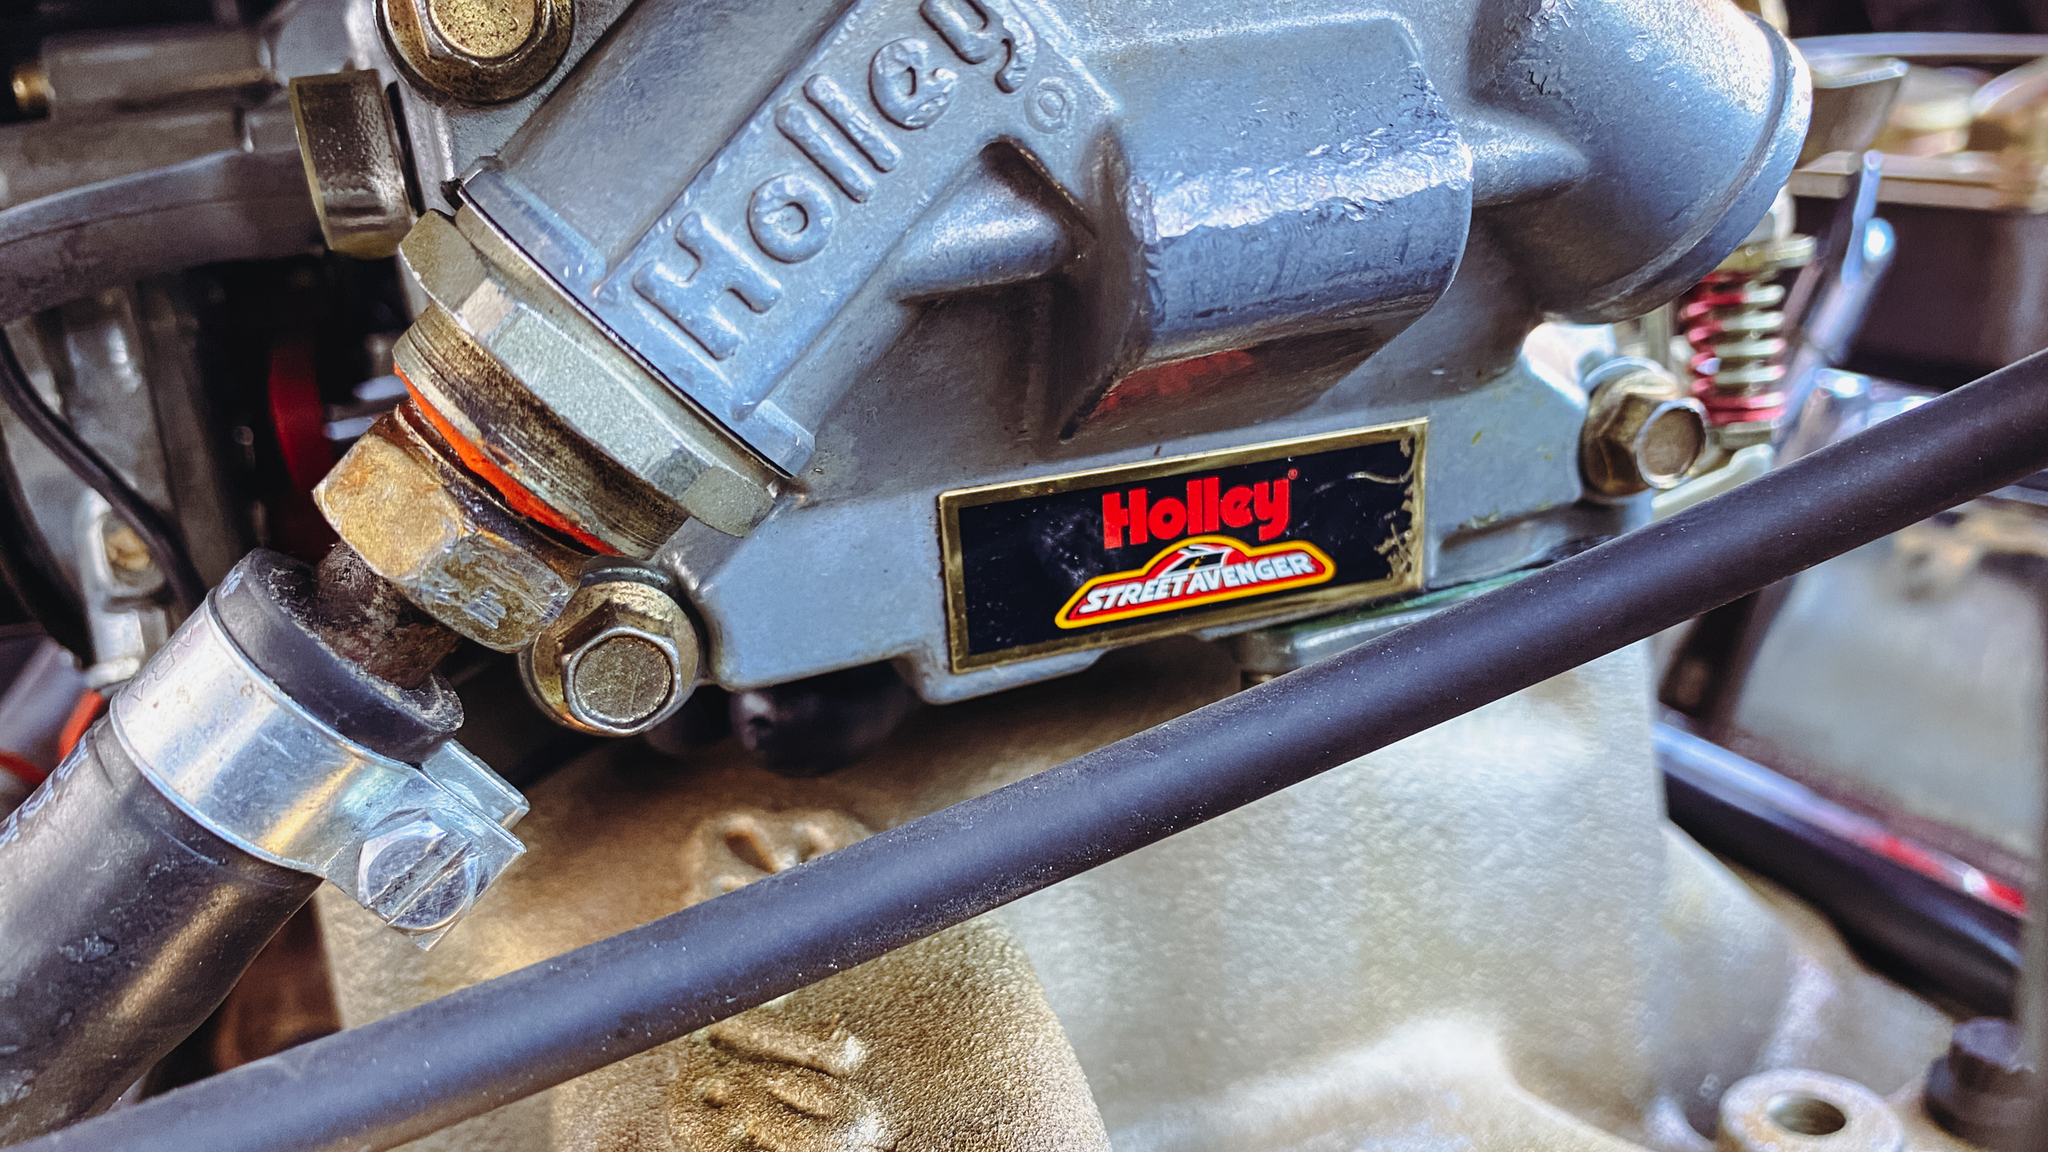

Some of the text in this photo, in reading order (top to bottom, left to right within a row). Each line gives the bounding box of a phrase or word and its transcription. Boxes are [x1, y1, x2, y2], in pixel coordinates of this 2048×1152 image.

[632, 0, 1038, 361] Holley
[1102, 476, 1290, 549] Holley
[1079, 552, 1317, 614] STREET AVENGER
